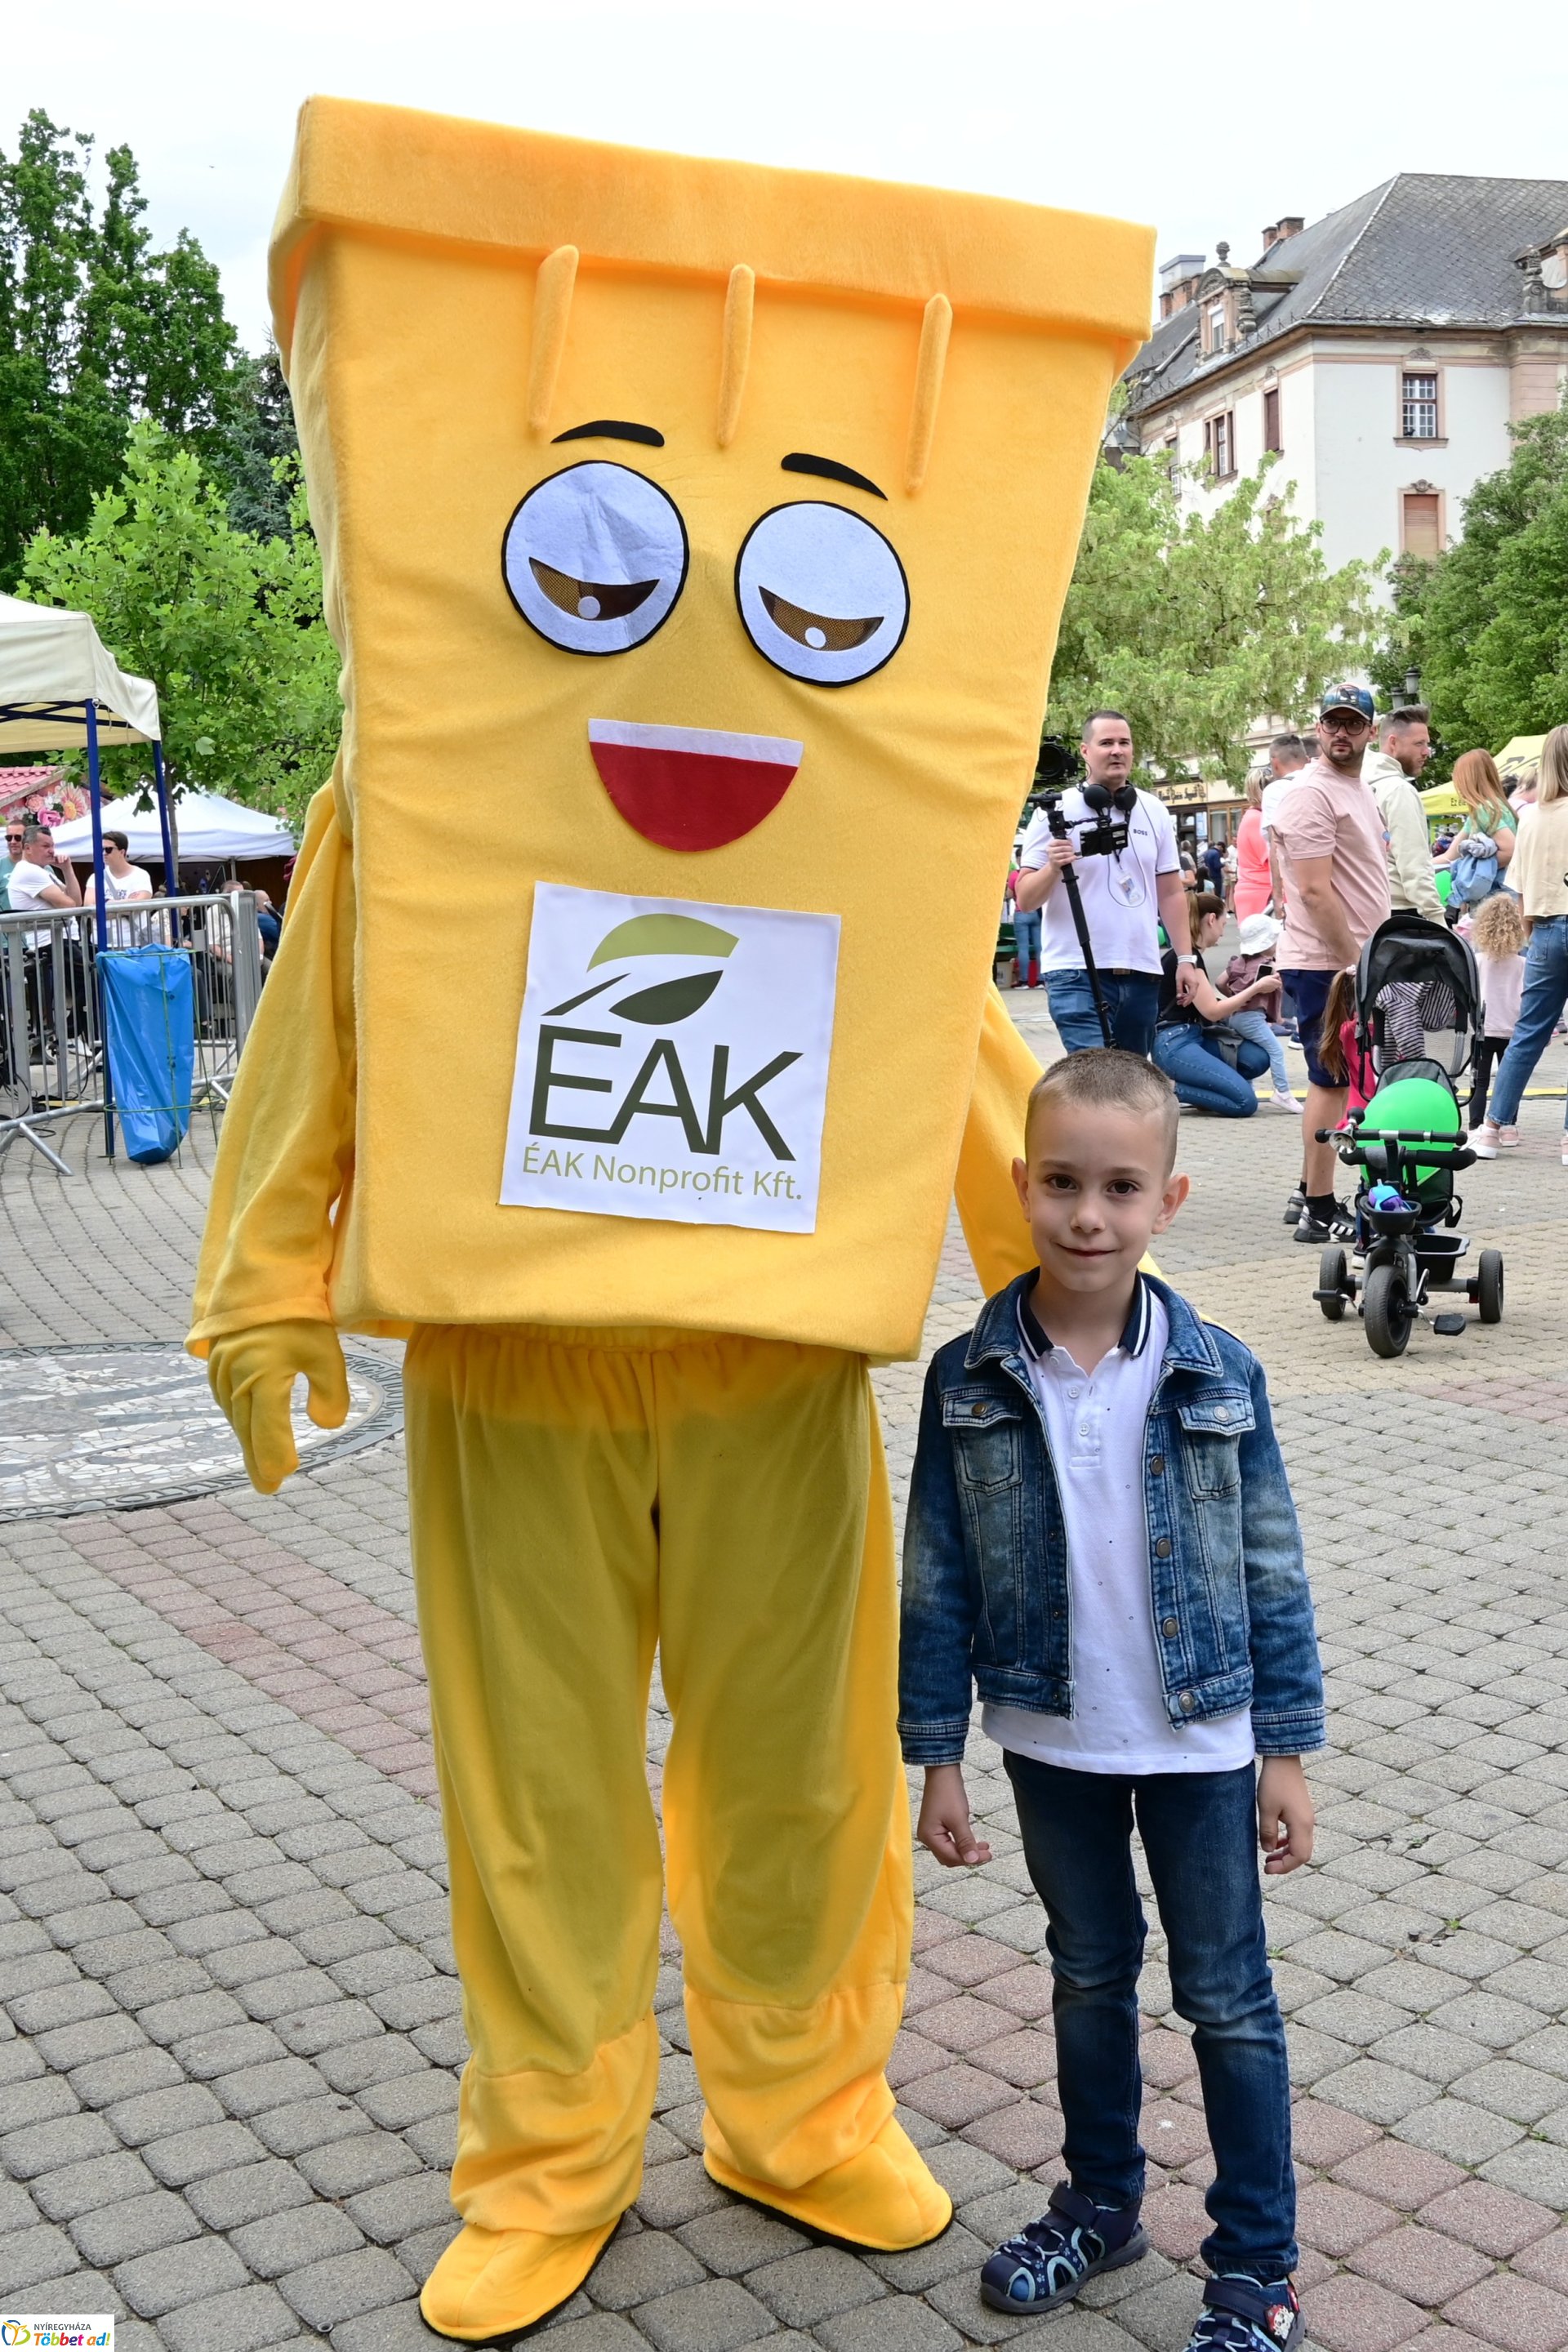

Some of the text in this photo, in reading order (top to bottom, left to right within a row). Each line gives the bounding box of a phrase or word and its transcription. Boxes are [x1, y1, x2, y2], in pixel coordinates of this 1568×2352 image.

[1133, 828, 1148, 836] BOSS
[523, 1142, 802, 1200] ÉAK Nonprofit Kft.
[0, 1342, 169, 1359] ÁVOLSÁG
